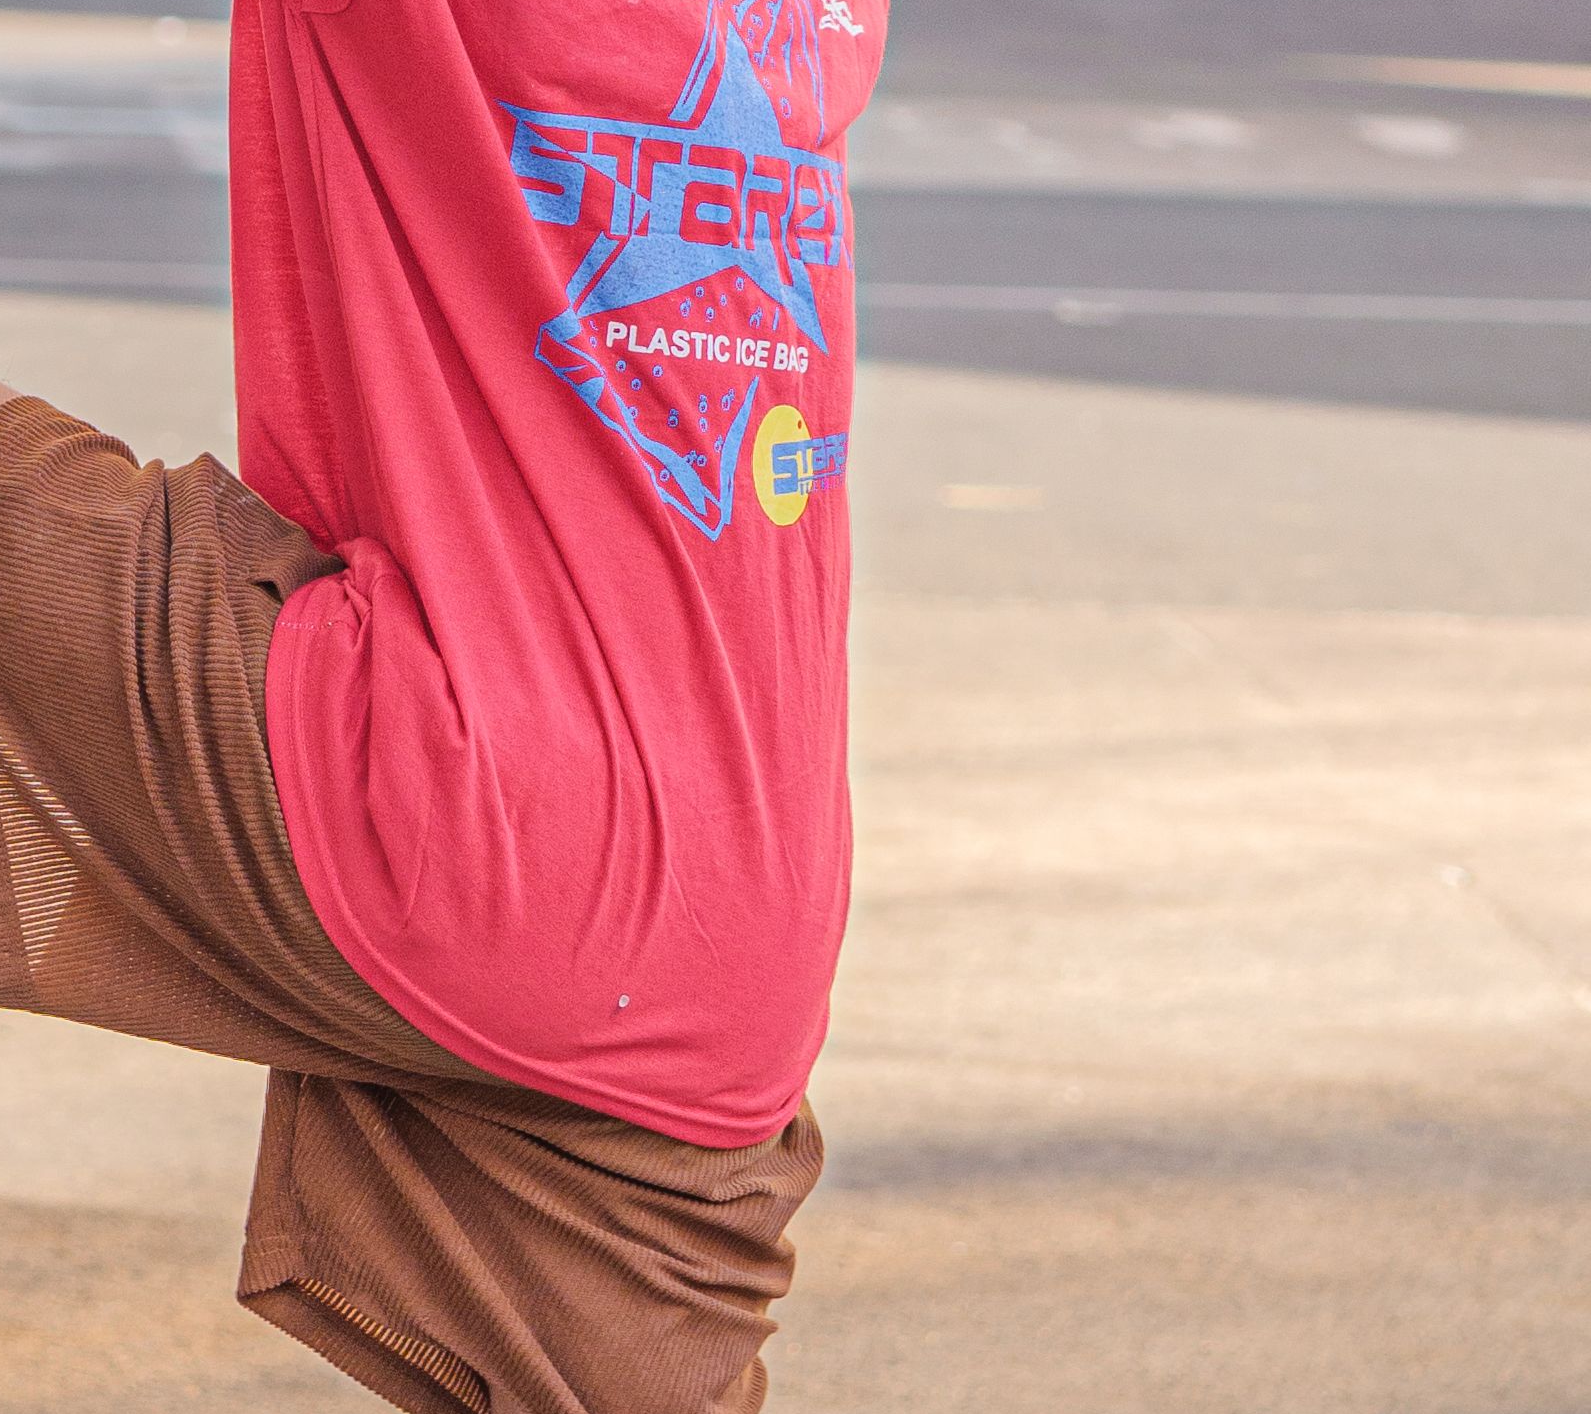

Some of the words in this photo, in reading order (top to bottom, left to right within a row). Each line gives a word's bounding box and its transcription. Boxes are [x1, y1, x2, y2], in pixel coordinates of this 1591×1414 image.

[606, 320, 730, 363] PLASTIC
[735, 337, 771, 369] ICE
[773, 342, 809, 374] BAG
